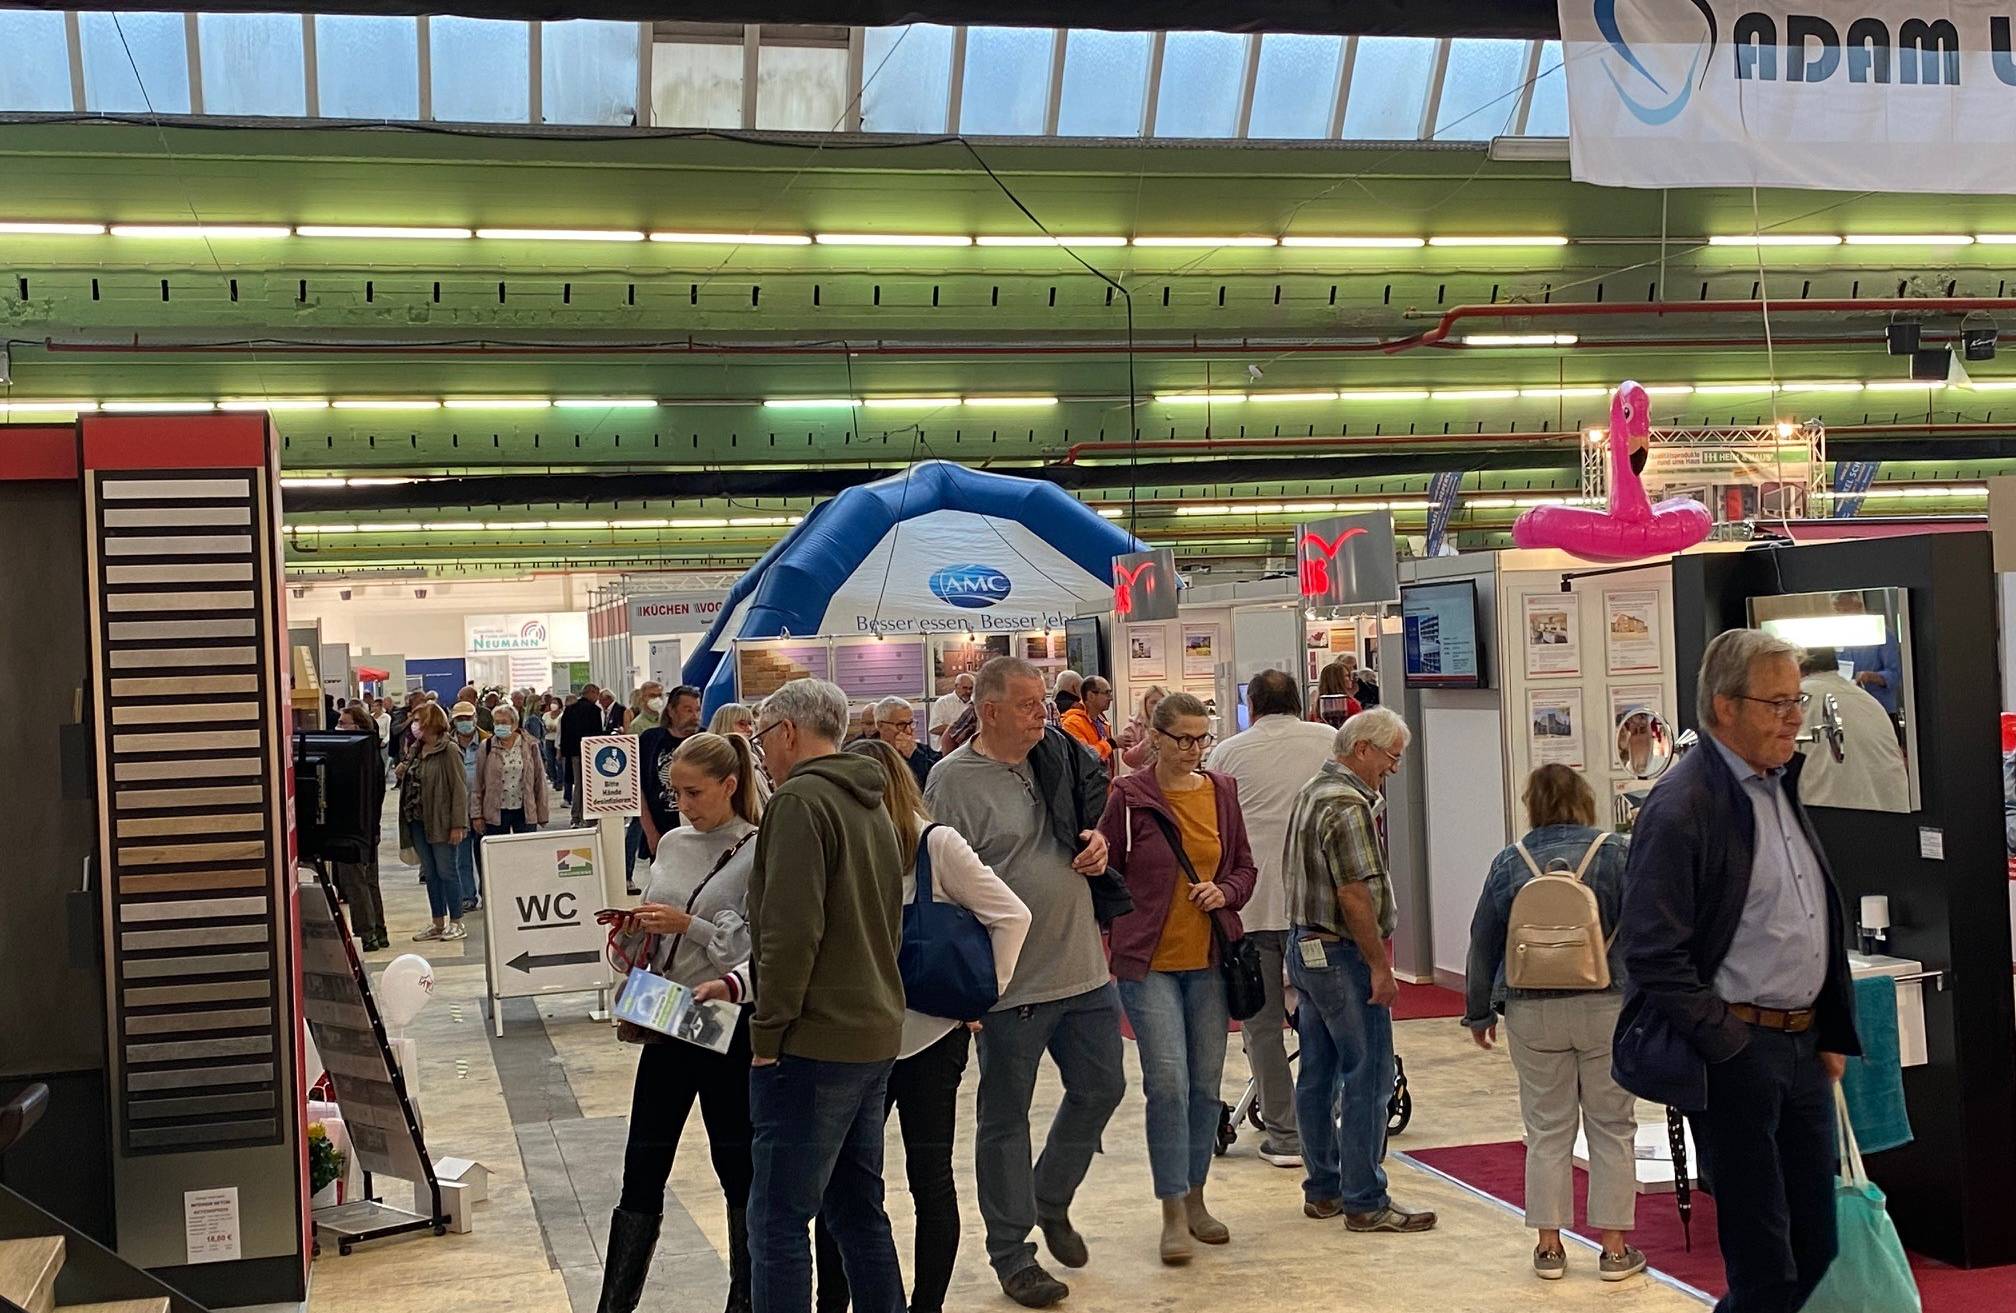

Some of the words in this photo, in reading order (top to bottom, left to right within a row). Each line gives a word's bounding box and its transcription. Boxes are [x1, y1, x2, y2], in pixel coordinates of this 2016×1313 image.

[1734, 12, 1960, 85] ADAM
[945, 575, 1009, 592] AMC
[643, 603, 689, 616] KÜCHEN
[856, 614, 914, 632] Besser
[981, 613, 1037, 629] Besser
[474, 637, 539, 649] NEUMANN
[516, 892, 578, 923] WC
